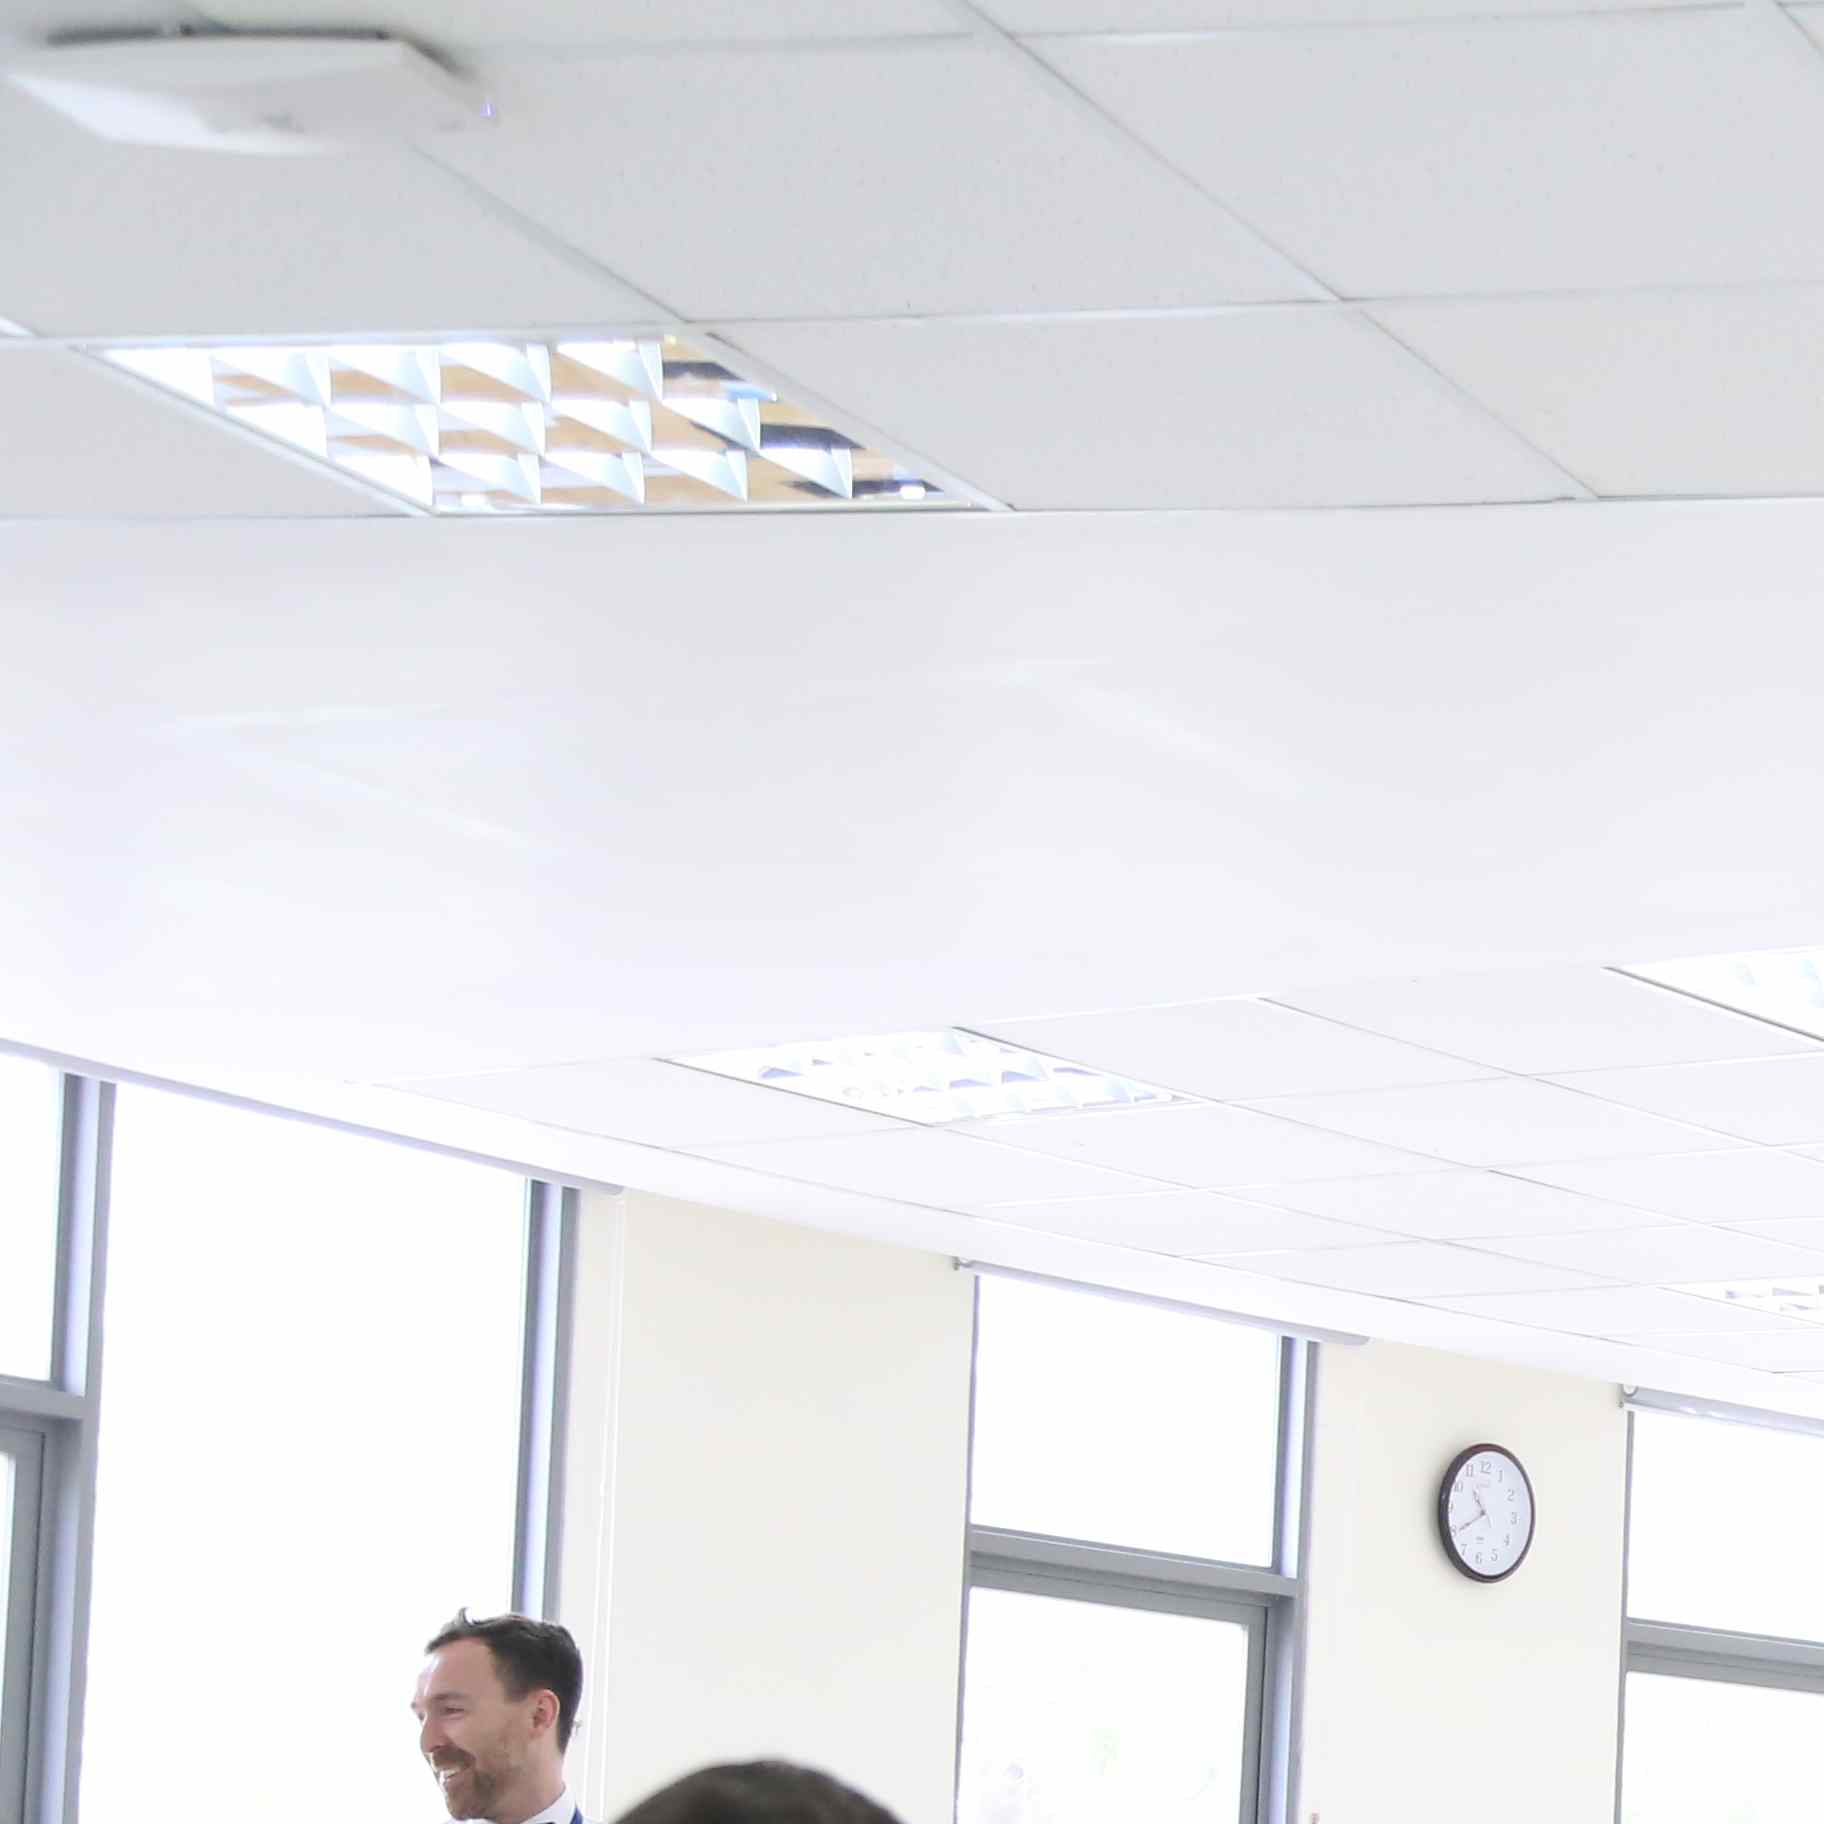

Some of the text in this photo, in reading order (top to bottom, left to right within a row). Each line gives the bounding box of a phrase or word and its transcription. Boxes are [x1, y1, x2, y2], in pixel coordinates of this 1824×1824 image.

[1466, 1463, 1474, 1478] 11
[1480, 1461, 1491, 1474] 12
[1506, 1489, 1515, 1502] 2
[1510, 1511, 1518, 1525] 3
[1461, 1543, 1468, 1556] 7
[1490, 1548, 1498, 1562] 5
[1475, 1552, 1483, 1565] 6
